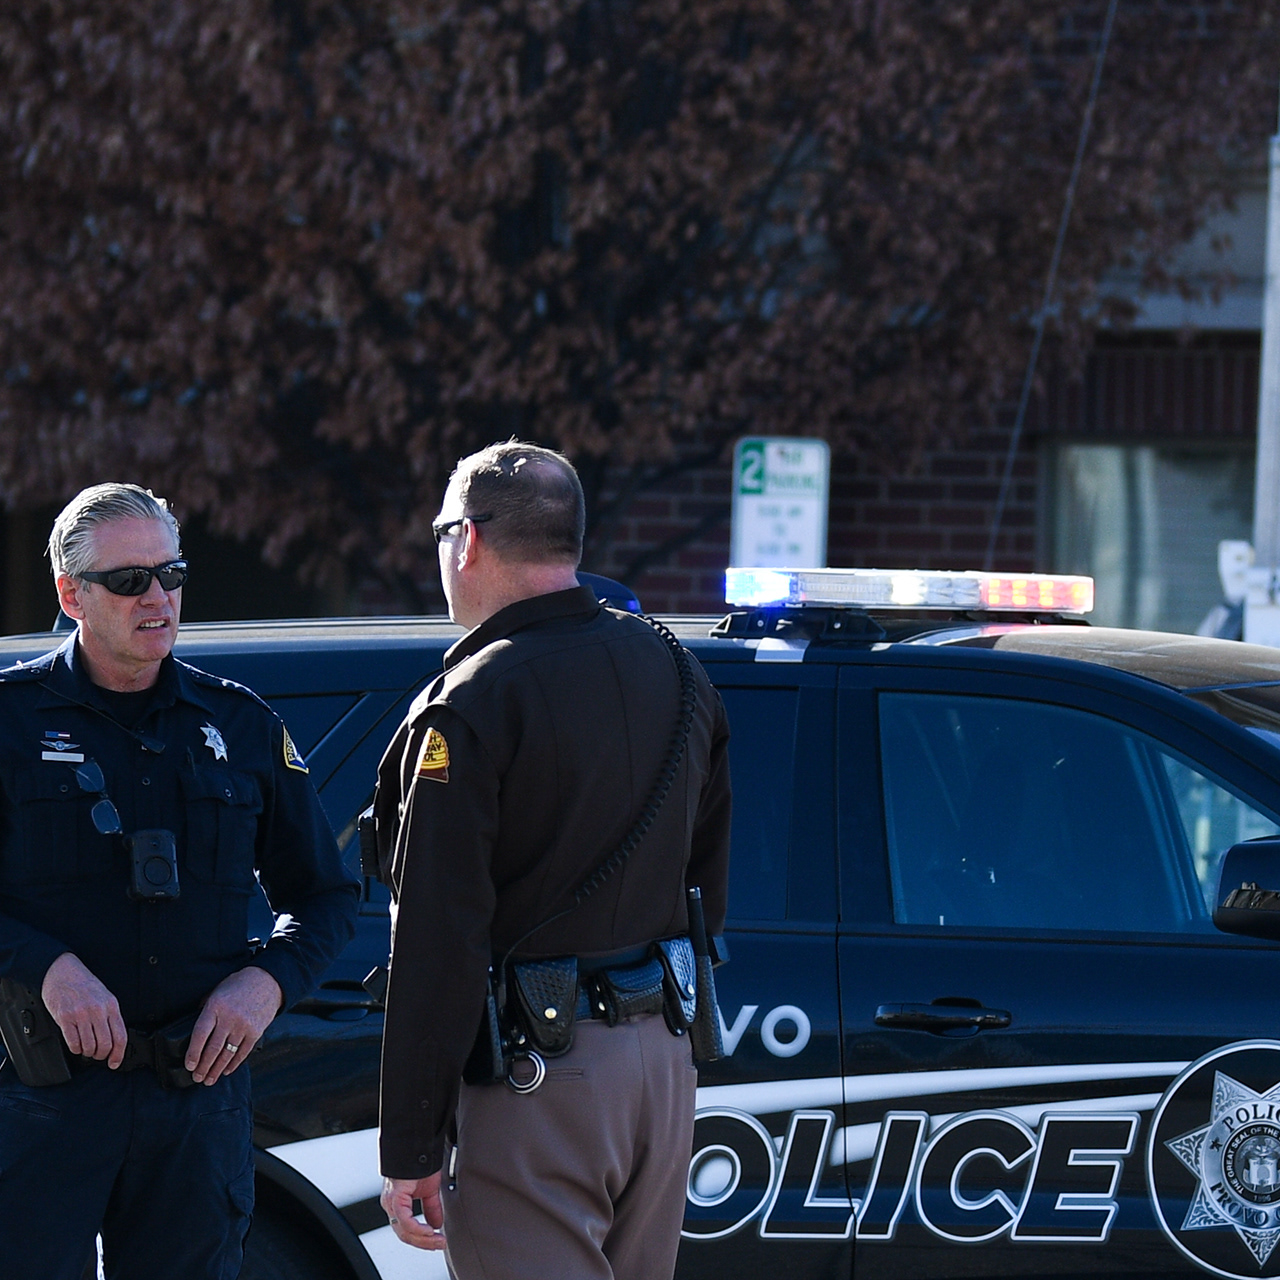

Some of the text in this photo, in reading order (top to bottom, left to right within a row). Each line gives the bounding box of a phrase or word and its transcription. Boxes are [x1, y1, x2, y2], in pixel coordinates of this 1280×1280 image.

[741, 450, 762, 489] 2
[1231, 1131, 1251, 1148] SEAL
[1263, 1128, 1279, 1137] THE
[680, 1111, 1138, 1243] OLICE
[1226, 1149, 1235, 1178] GREAT
[1231, 1176, 1245, 1195] THE
[1210, 1182, 1269, 1226] PROVO
